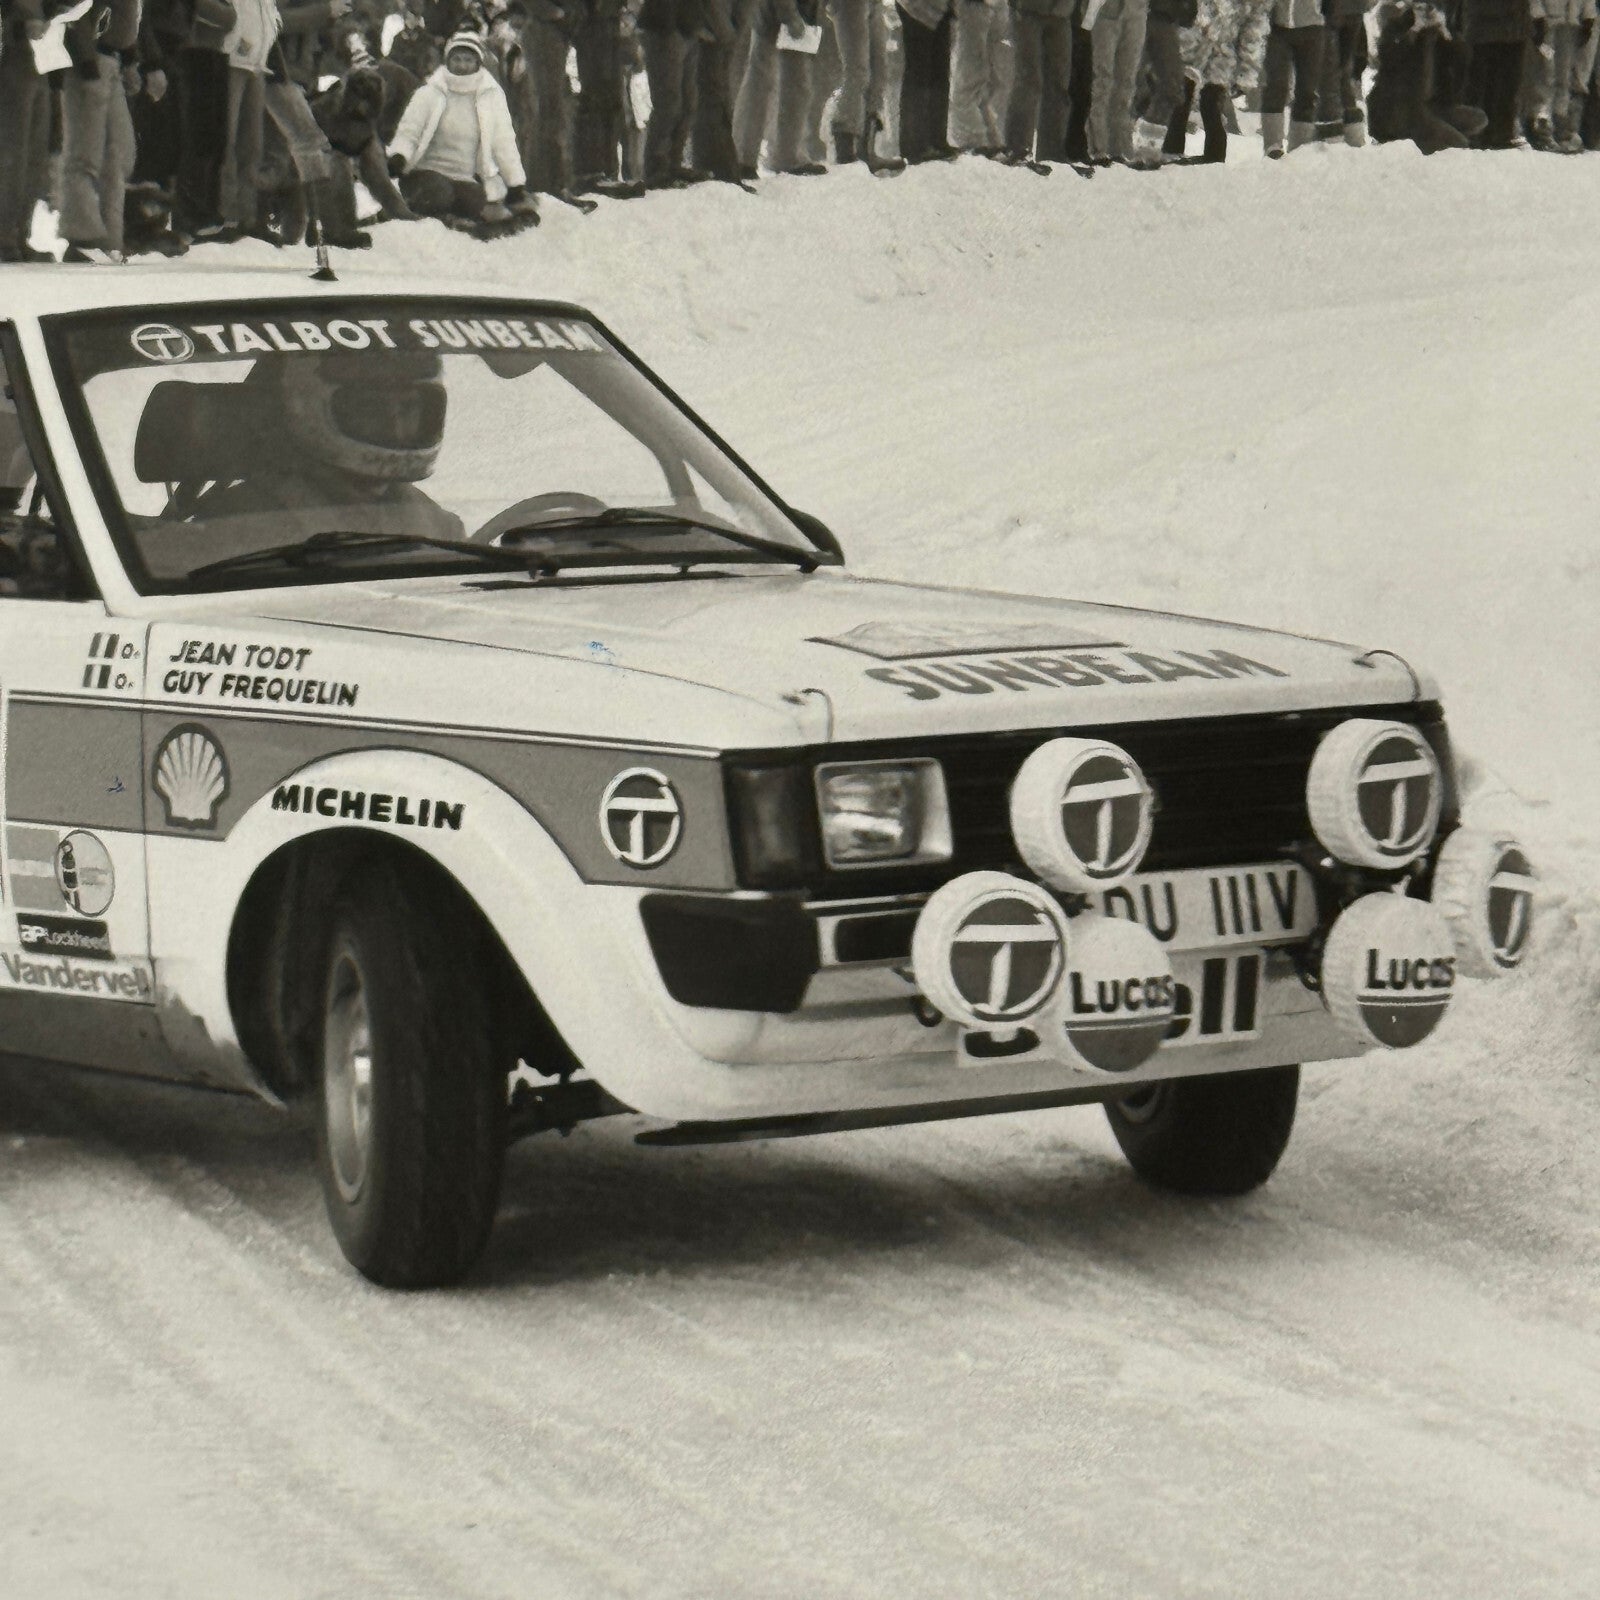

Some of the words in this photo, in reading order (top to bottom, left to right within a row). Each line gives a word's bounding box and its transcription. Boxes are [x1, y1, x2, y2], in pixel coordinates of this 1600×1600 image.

[198, 320, 398, 354] TALBOT
[408, 319, 603, 352] SUNBEAM
[169, 640, 237, 667] JEAN
[244, 643, 313, 672] TODT
[864, 648, 1291, 701] SUNBEAM
[163, 669, 213, 696] GUY
[219, 673, 360, 707] FREQUELIN
[271, 784, 466, 831] MICHELIN
[2, 951, 151, 998] Vandervell
